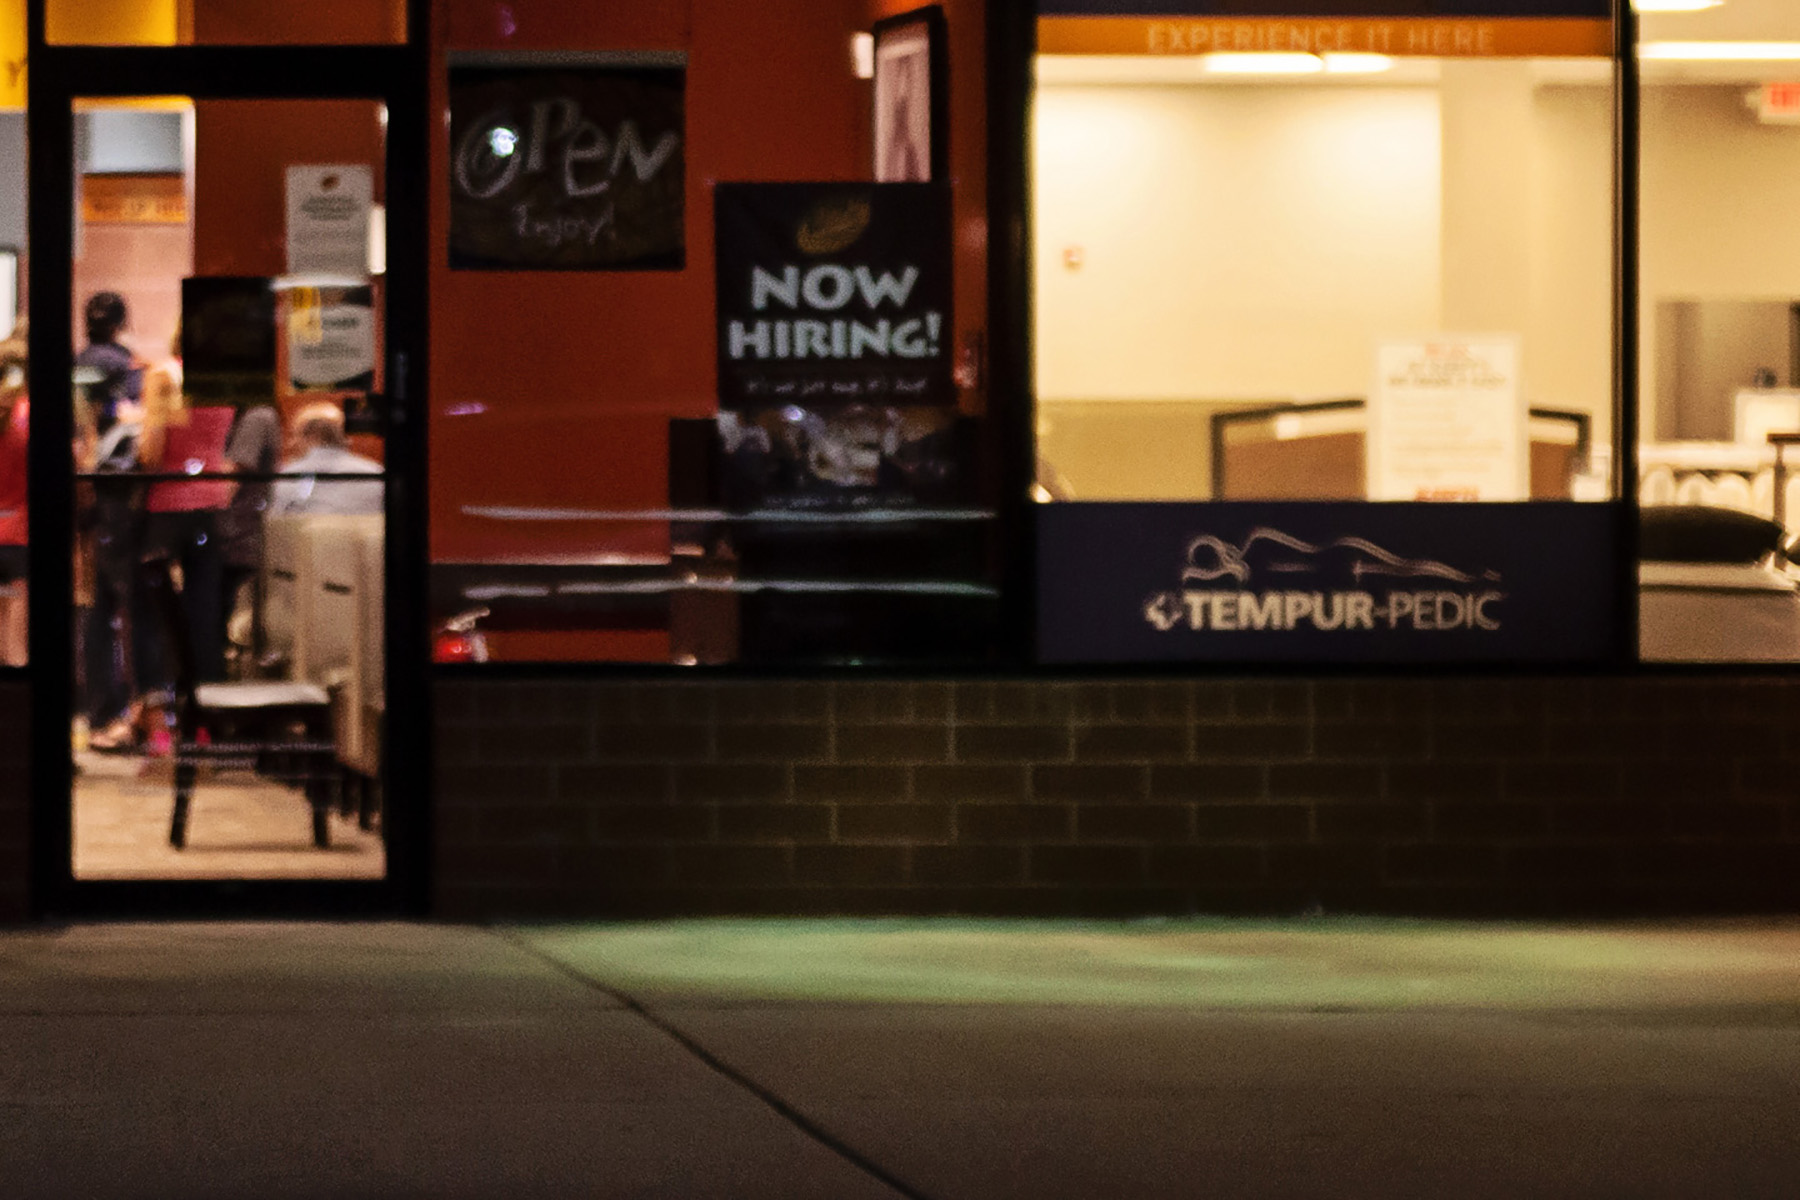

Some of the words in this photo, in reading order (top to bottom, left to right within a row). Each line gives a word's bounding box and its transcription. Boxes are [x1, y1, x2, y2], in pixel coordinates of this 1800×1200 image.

[1146, 22, 1353, 54] EXPERIENCE
[1364, 22, 1393, 54] IT
[1406, 22, 1496, 54] HERE
[752, 264, 919, 311] NOW
[728, 311, 942, 359] HIRING!
[1184, 589, 1503, 631] TEMPUR-PEDIC
